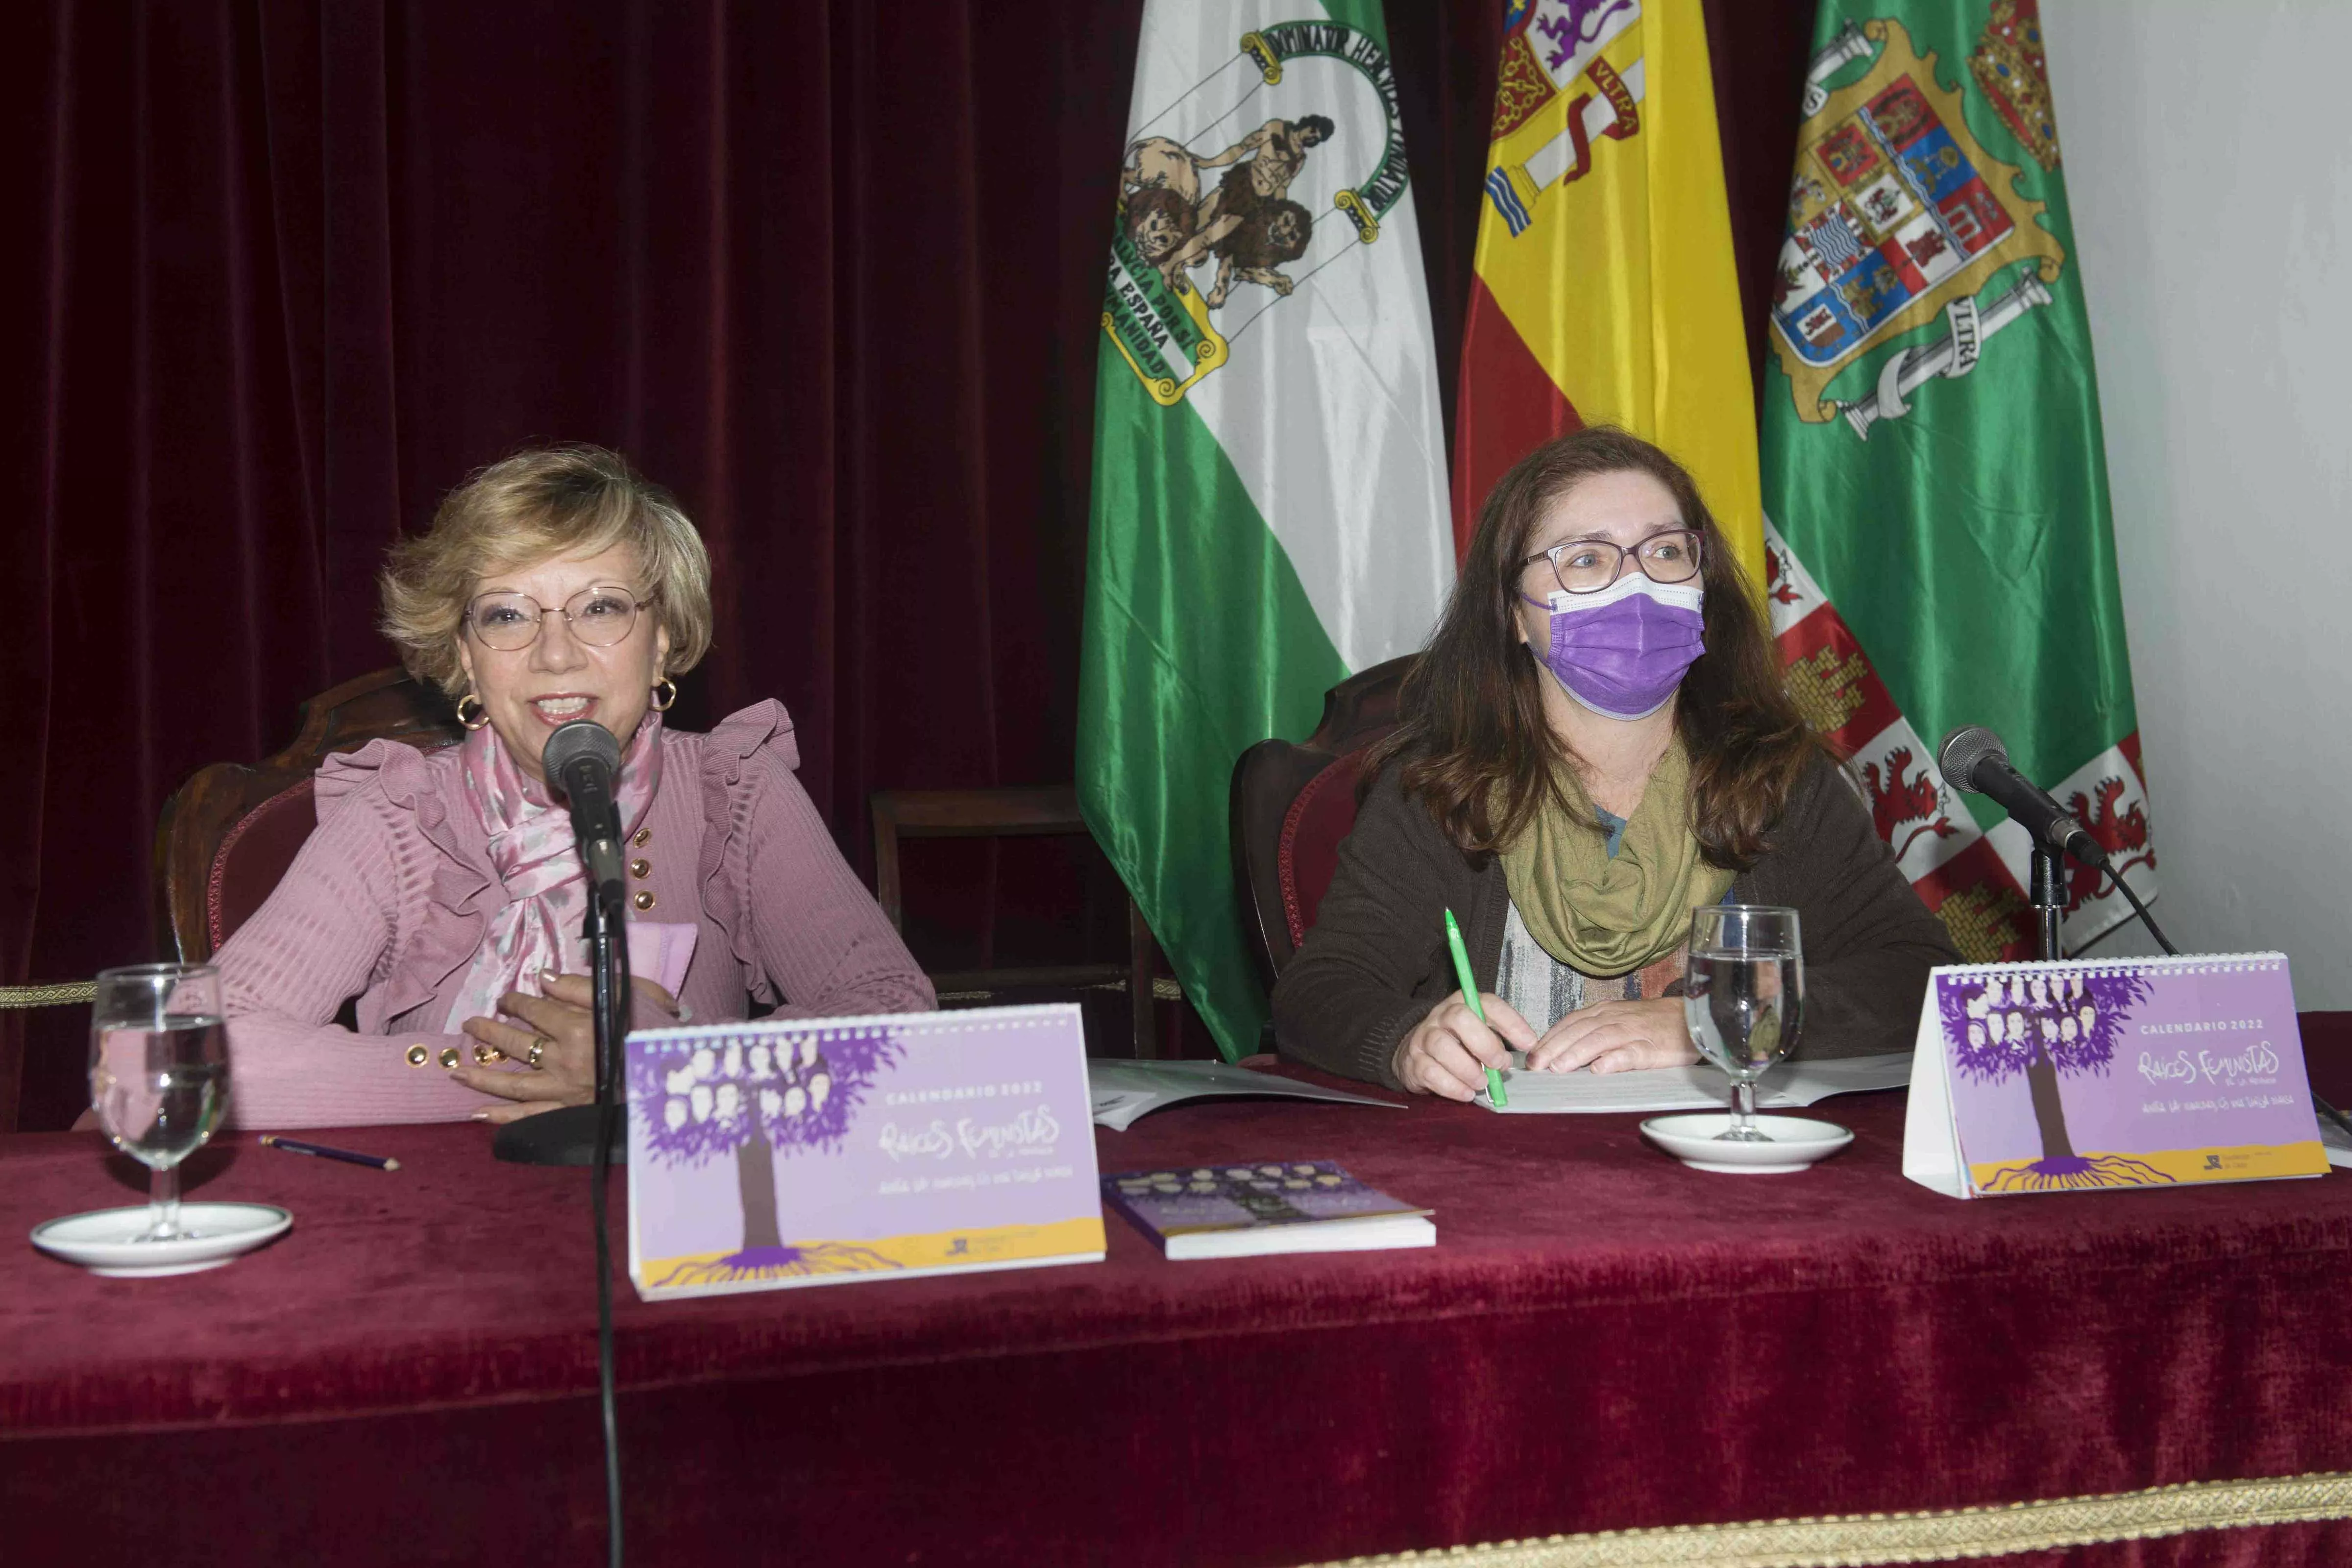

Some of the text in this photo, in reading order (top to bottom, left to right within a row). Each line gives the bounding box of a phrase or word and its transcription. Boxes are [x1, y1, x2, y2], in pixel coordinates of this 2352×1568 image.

[1119, 281, 1169, 349] ESPAÑA
[1152, 294, 1180, 330] POR
[2140, 1019, 2264, 1035] CALENDARIO 2022
